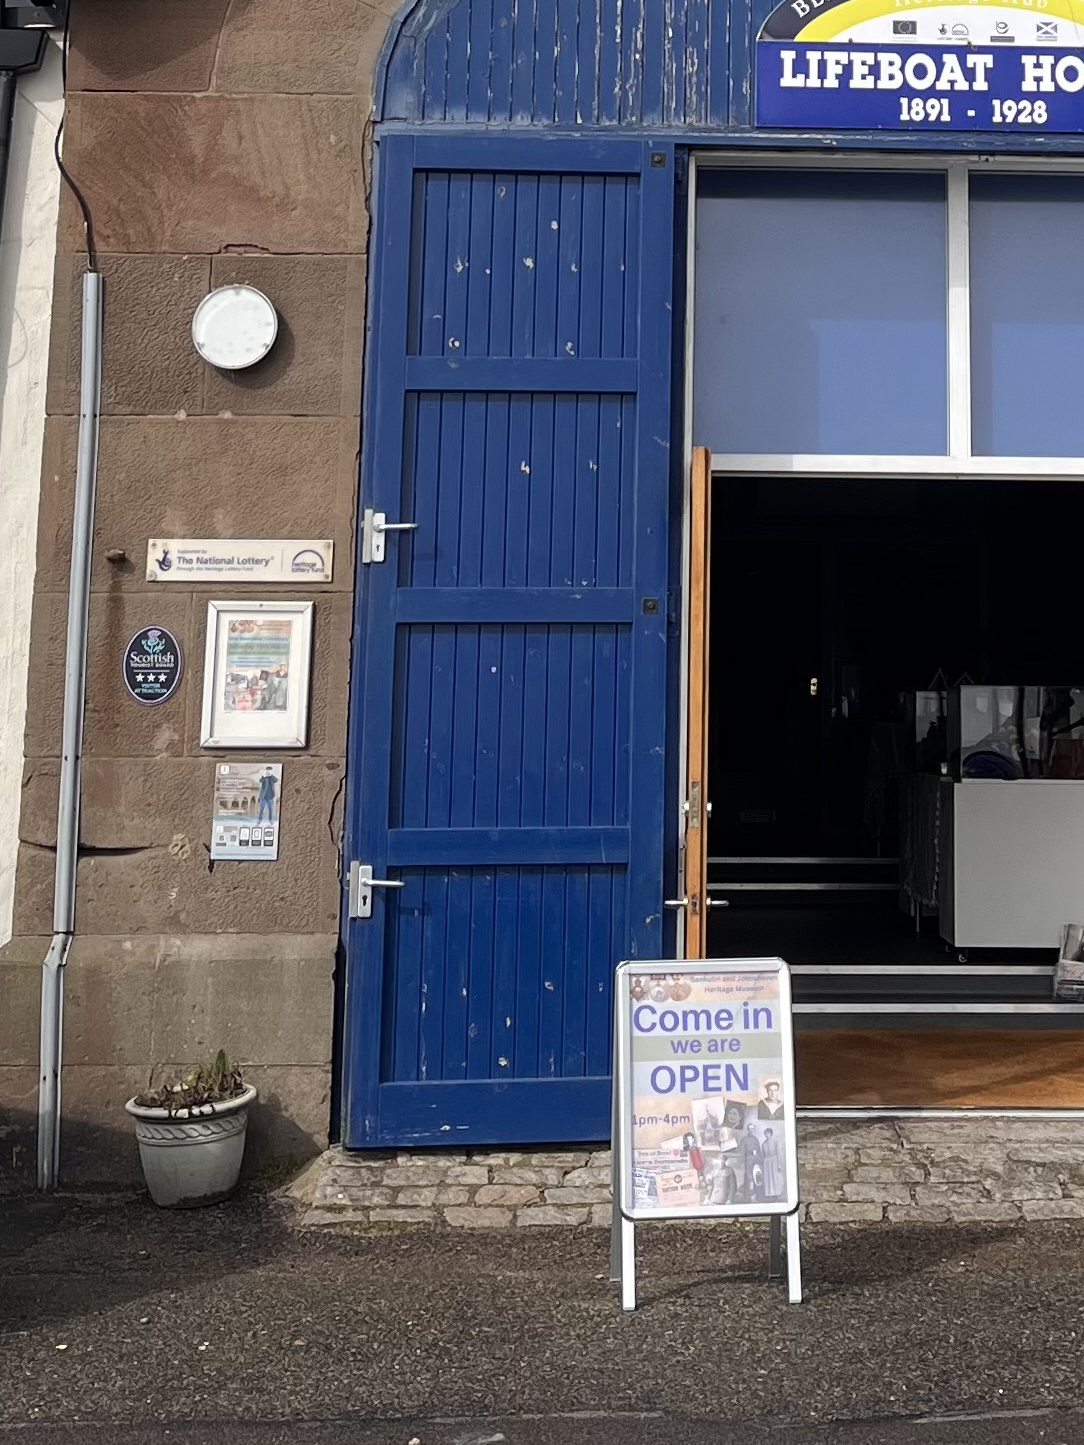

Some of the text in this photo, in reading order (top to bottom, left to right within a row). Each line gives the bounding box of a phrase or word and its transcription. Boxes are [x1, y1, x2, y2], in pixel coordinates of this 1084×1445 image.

[779, 49, 994, 92] LIFEBOAT
[899, 97, 951, 123] 1891
[992, 99, 1048, 125] 1928
[176, 556, 271, 567] The National Lottery
[129, 651, 175, 663] Scottish
[704, 985, 734, 994] Heritage
[633, 1001, 773, 1033] Come in
[670, 1037, 741, 1054] we are
[650, 1063, 750, 1094] OPEN
[631, 1113, 690, 1128] 1pm-4pm
